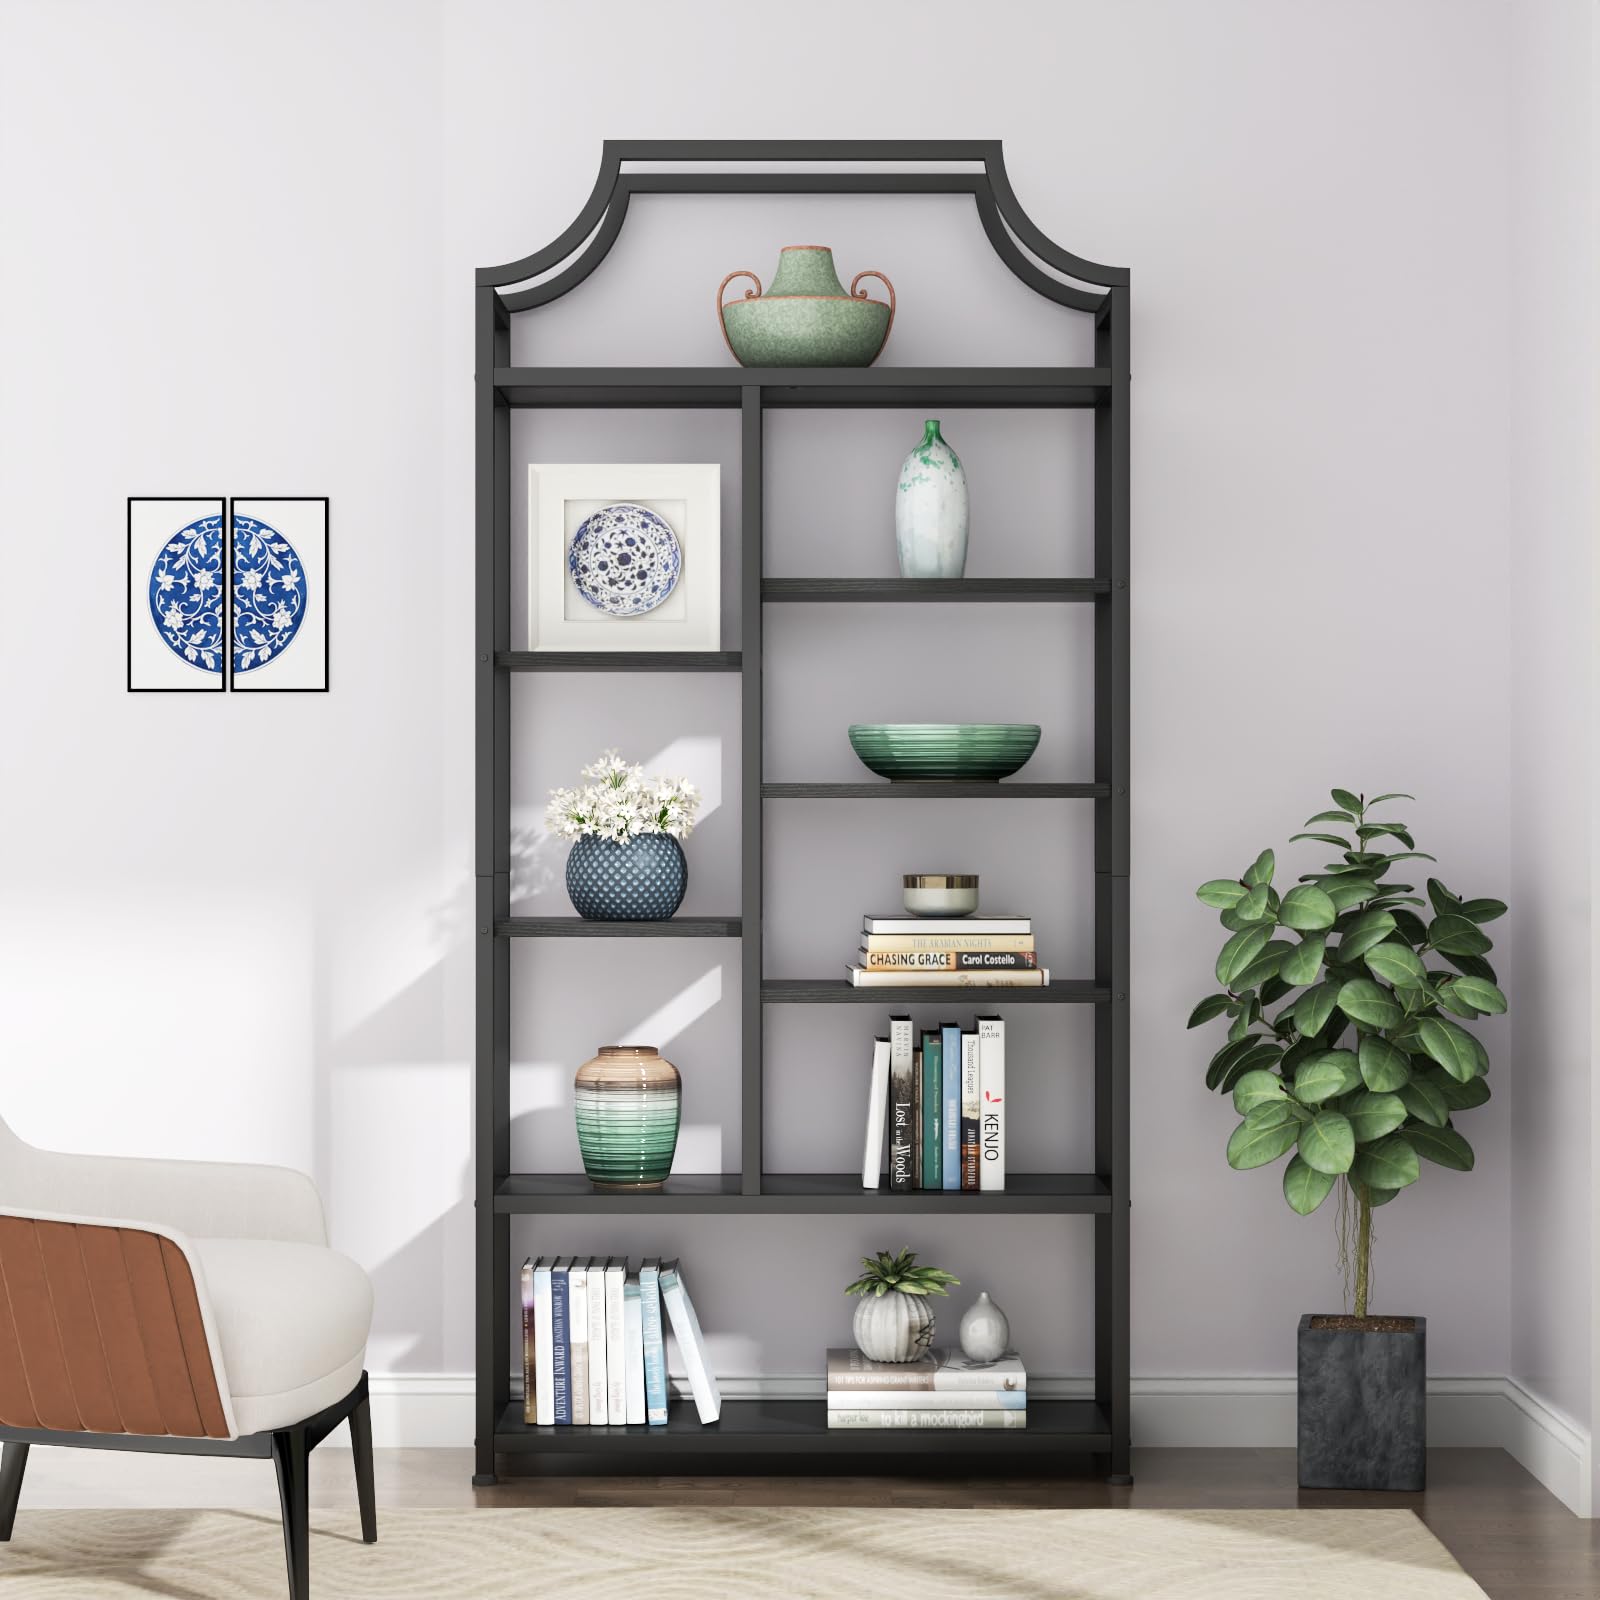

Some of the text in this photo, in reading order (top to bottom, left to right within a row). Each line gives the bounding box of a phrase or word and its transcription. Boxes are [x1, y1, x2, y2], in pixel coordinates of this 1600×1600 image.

[912, 938, 992, 949] THE ARABIAN NIGHTS
[870, 954, 951, 966] CHASING GRACE
[962, 954, 983, 965] Carol
[984, 954, 1015, 965] Costello
[965, 1040, 976, 1094] Thousand Leagues
[895, 1102, 911, 1127] Lost
[895, 1136, 904, 1145] the
[984, 1113, 999, 1161] KENJO
[895, 1144, 911, 1183] Woods
[553, 1345, 565, 1376] INWARD
[554, 1377, 567, 1420] ADVENTURE
[881, 1410, 984, 1428] to kill a mockingbird
